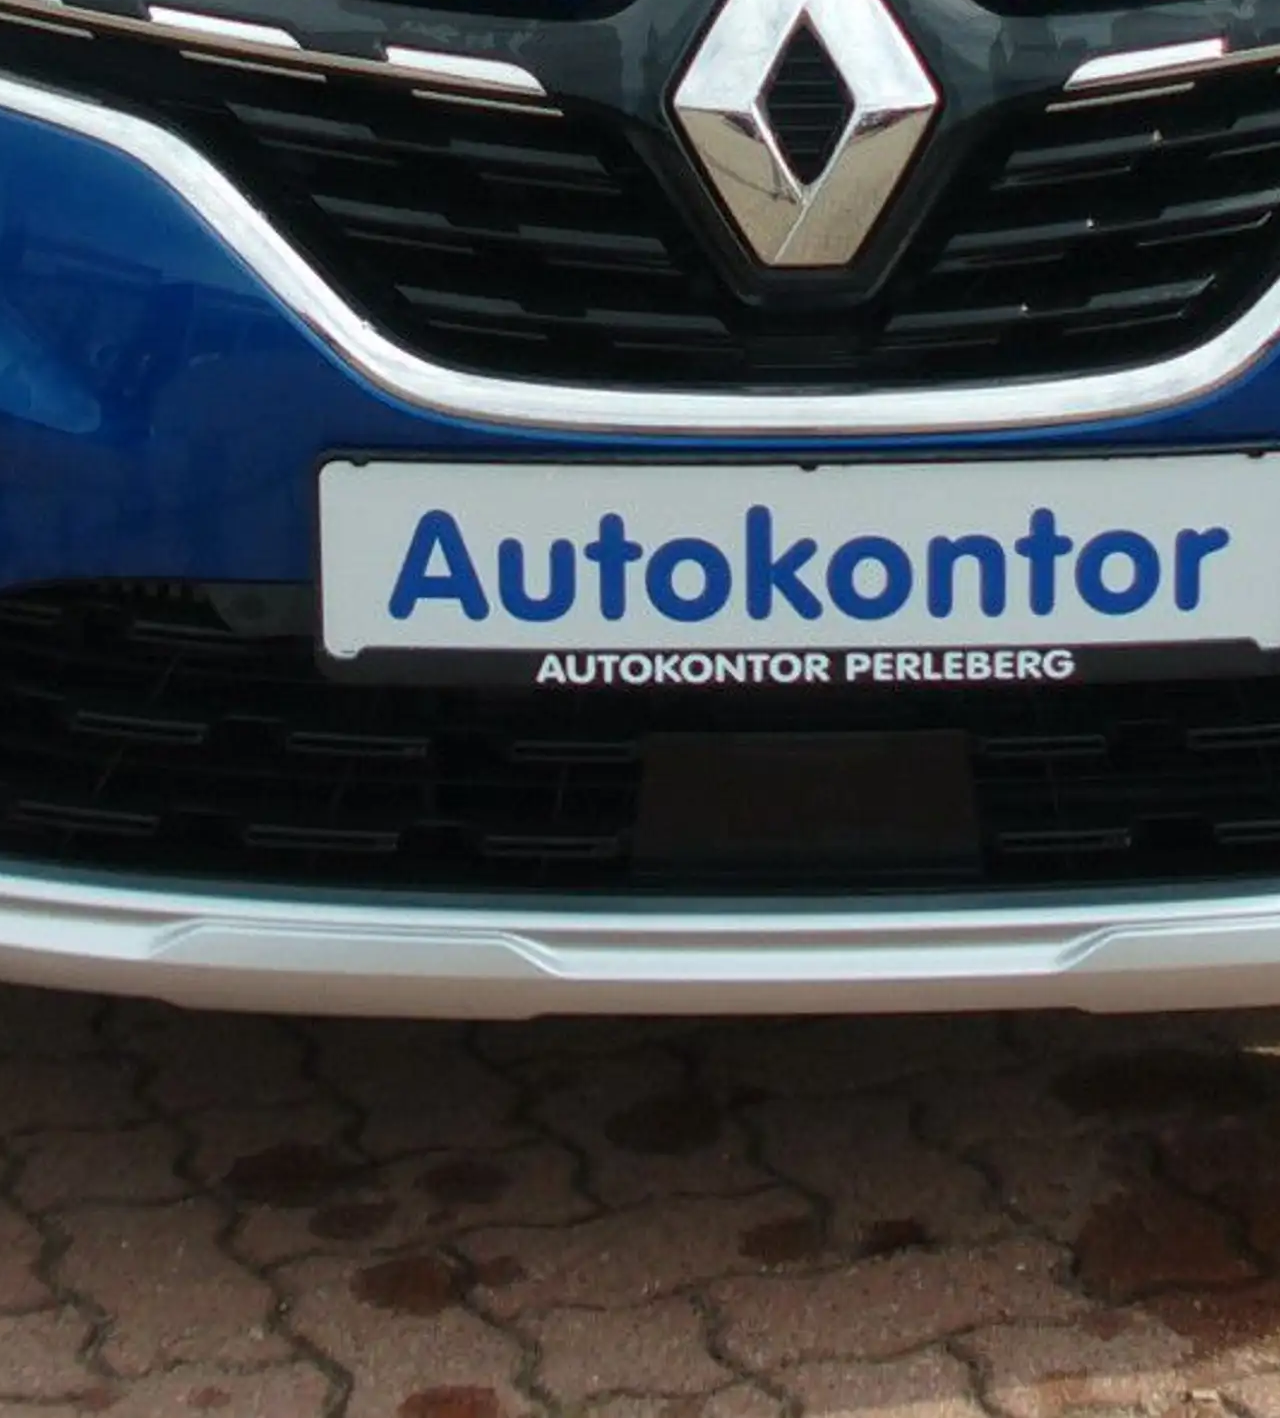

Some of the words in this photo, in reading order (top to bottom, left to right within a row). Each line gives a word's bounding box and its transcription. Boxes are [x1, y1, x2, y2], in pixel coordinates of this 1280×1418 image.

[387, 503, 1231, 623] Autokontor
[535, 651, 832, 685] AUTOKONTOR
[845, 649, 1077, 683] PERLEBERG
